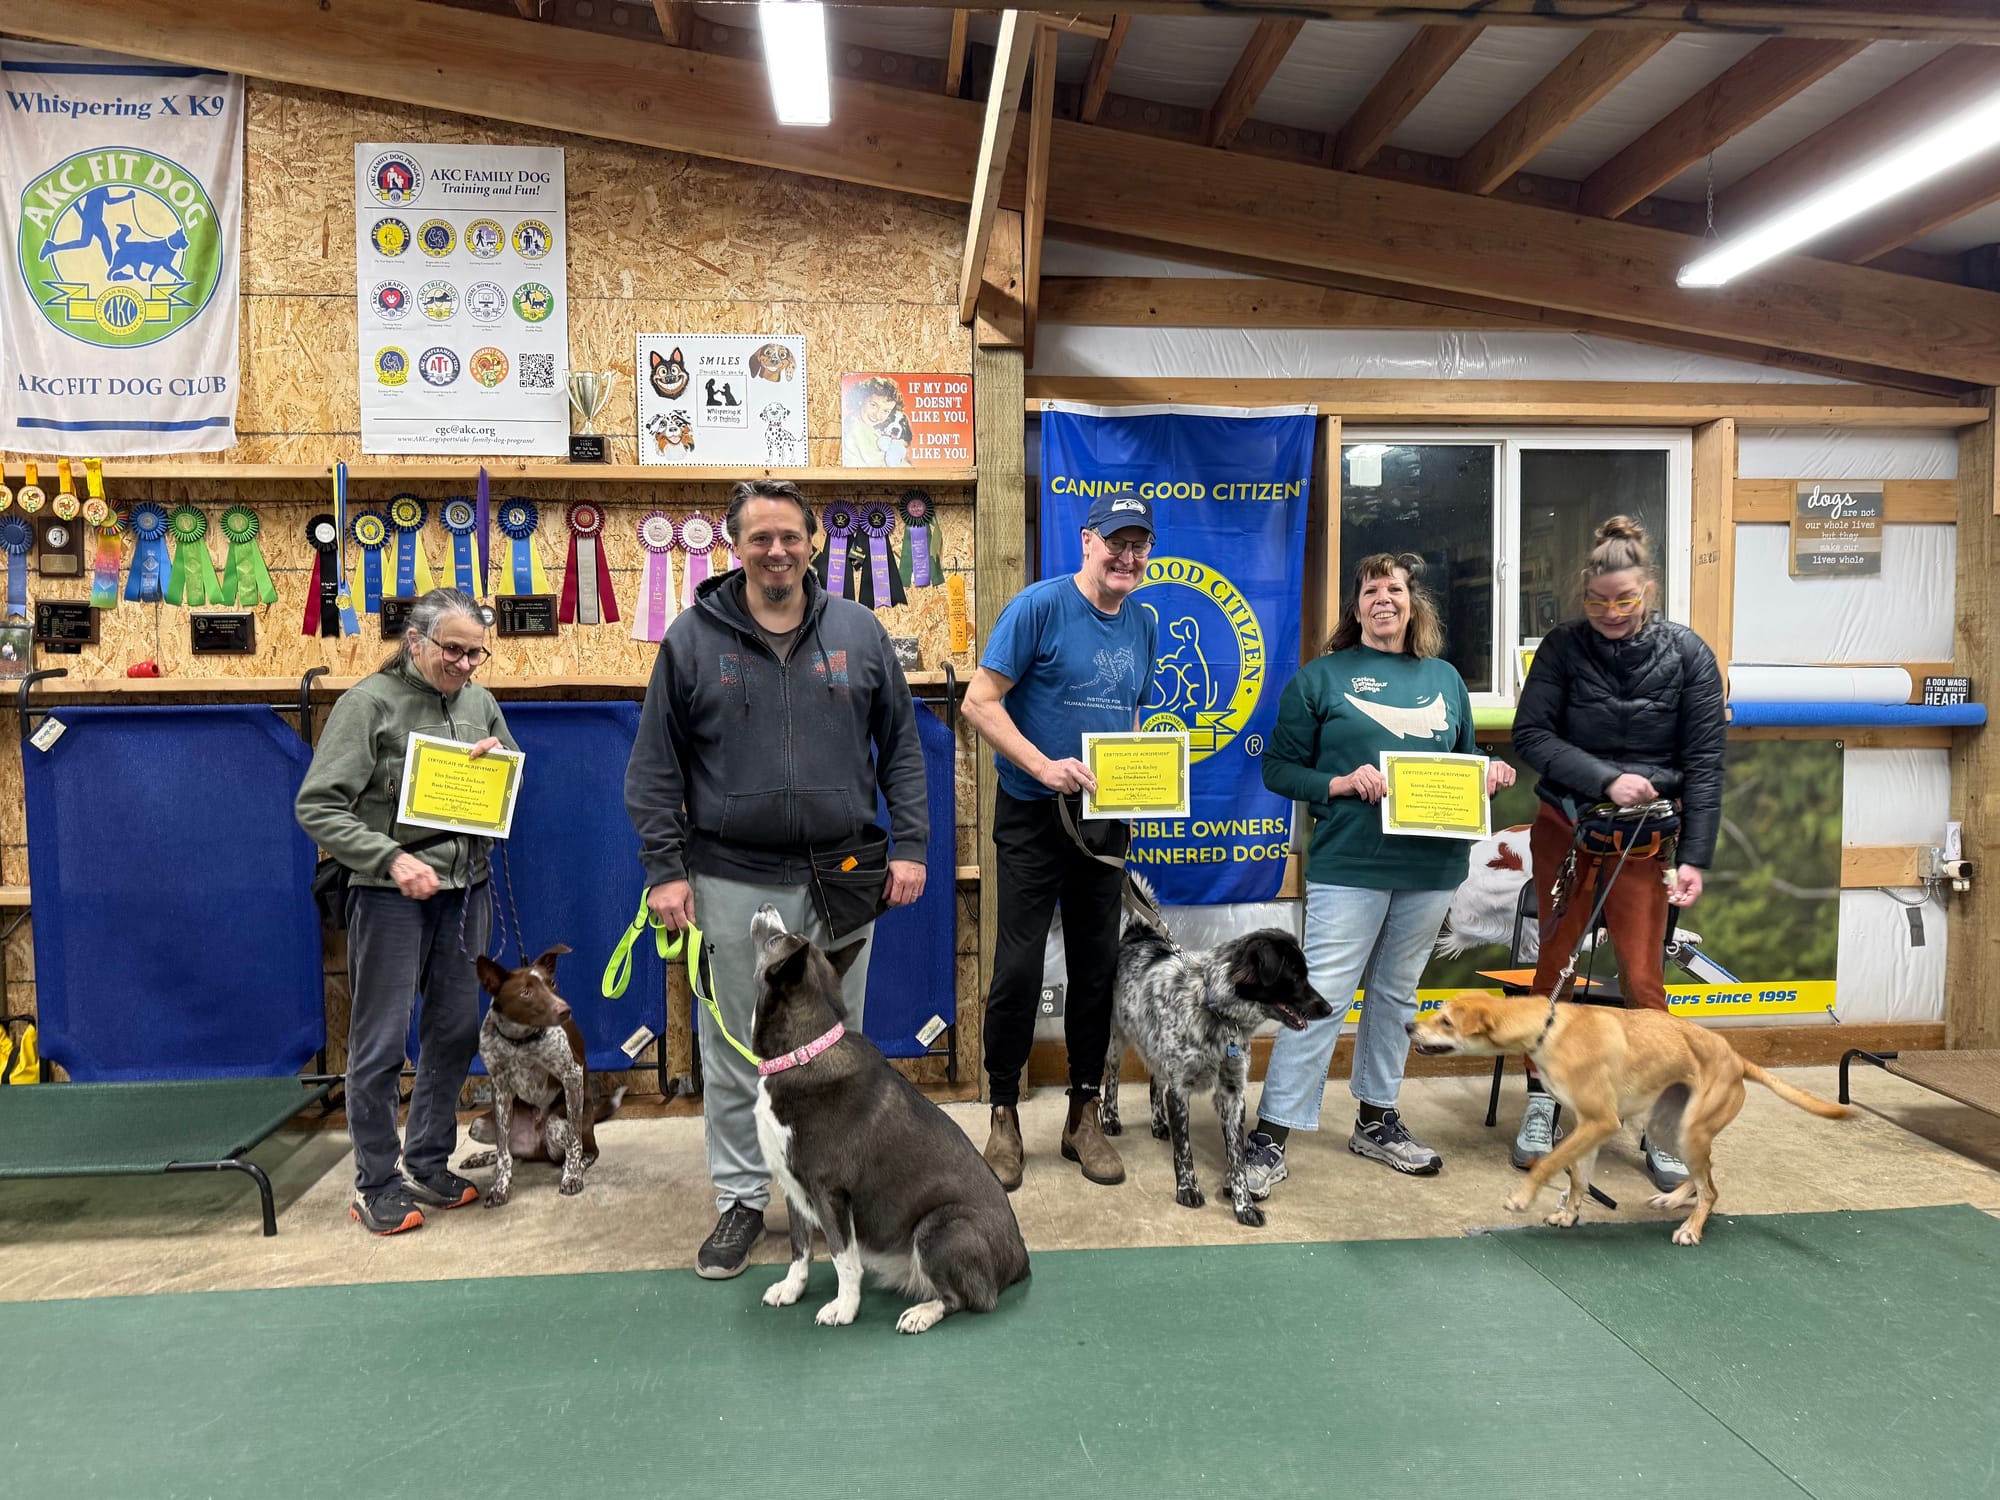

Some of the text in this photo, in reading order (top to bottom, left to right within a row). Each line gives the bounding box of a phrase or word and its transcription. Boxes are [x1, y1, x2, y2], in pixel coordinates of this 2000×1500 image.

[6, 90, 225, 120] Whispering X K9
[371, 155, 389, 173] FAMILY
[389, 153, 404, 161] DOG
[404, 157, 421, 188] PROGRAM
[430, 168, 551, 184] AKC FAMILY DOG
[24, 152, 210, 232] AKC FIT DOG
[441, 182, 541, 198] Training and Fun!
[521, 220, 543, 229] URBAN
[418, 281, 458, 302] AKC TRICK DOG
[476, 282, 492, 290] HOME
[514, 283, 552, 301] AKC FIT DOG
[376, 281, 404, 291] THERAPY
[402, 287, 411, 306] DOG
[105, 296, 137, 327] AKC
[699, 356, 741, 366] SMILES
[18, 372, 228, 397] AKC FIT DOG CLUB
[908, 382, 968, 394] IF MY DOG
[915, 396, 963, 409] DOESN'T
[707, 408, 742, 416] Whispering X
[911, 410, 969, 425] LIKE YOU,
[719, 416, 741, 424] Training
[435, 424, 497, 438] cgc@akc.org
[919, 433, 960, 445] I DON'T
[911, 447, 969, 460] LIKE YOU.
[1051, 476, 1134, 498] CANINE
[1139, 482, 1206, 500] GOOD
[1807, 484, 1876, 520] dogs are not
[1805, 520, 1875, 529] our whole lives
[1821, 531, 1859, 542] but they
[1819, 543, 1858, 552] make our
[1812, 555, 1864, 565] lives whole
[1146, 561, 1262, 683] OOD CITIZEN
[1932, 679, 1946, 687] DOG
[1947, 679, 1967, 687] WAGS
[1086, 696, 1111, 704] INSTITUTE
[1925, 692, 1967, 706] HEART
[1132, 817, 1289, 839] SIBLE OWNERS,
[1125, 846, 1227, 865] ANNERED
[1666, 990, 1798, 1006] lers since 1995
